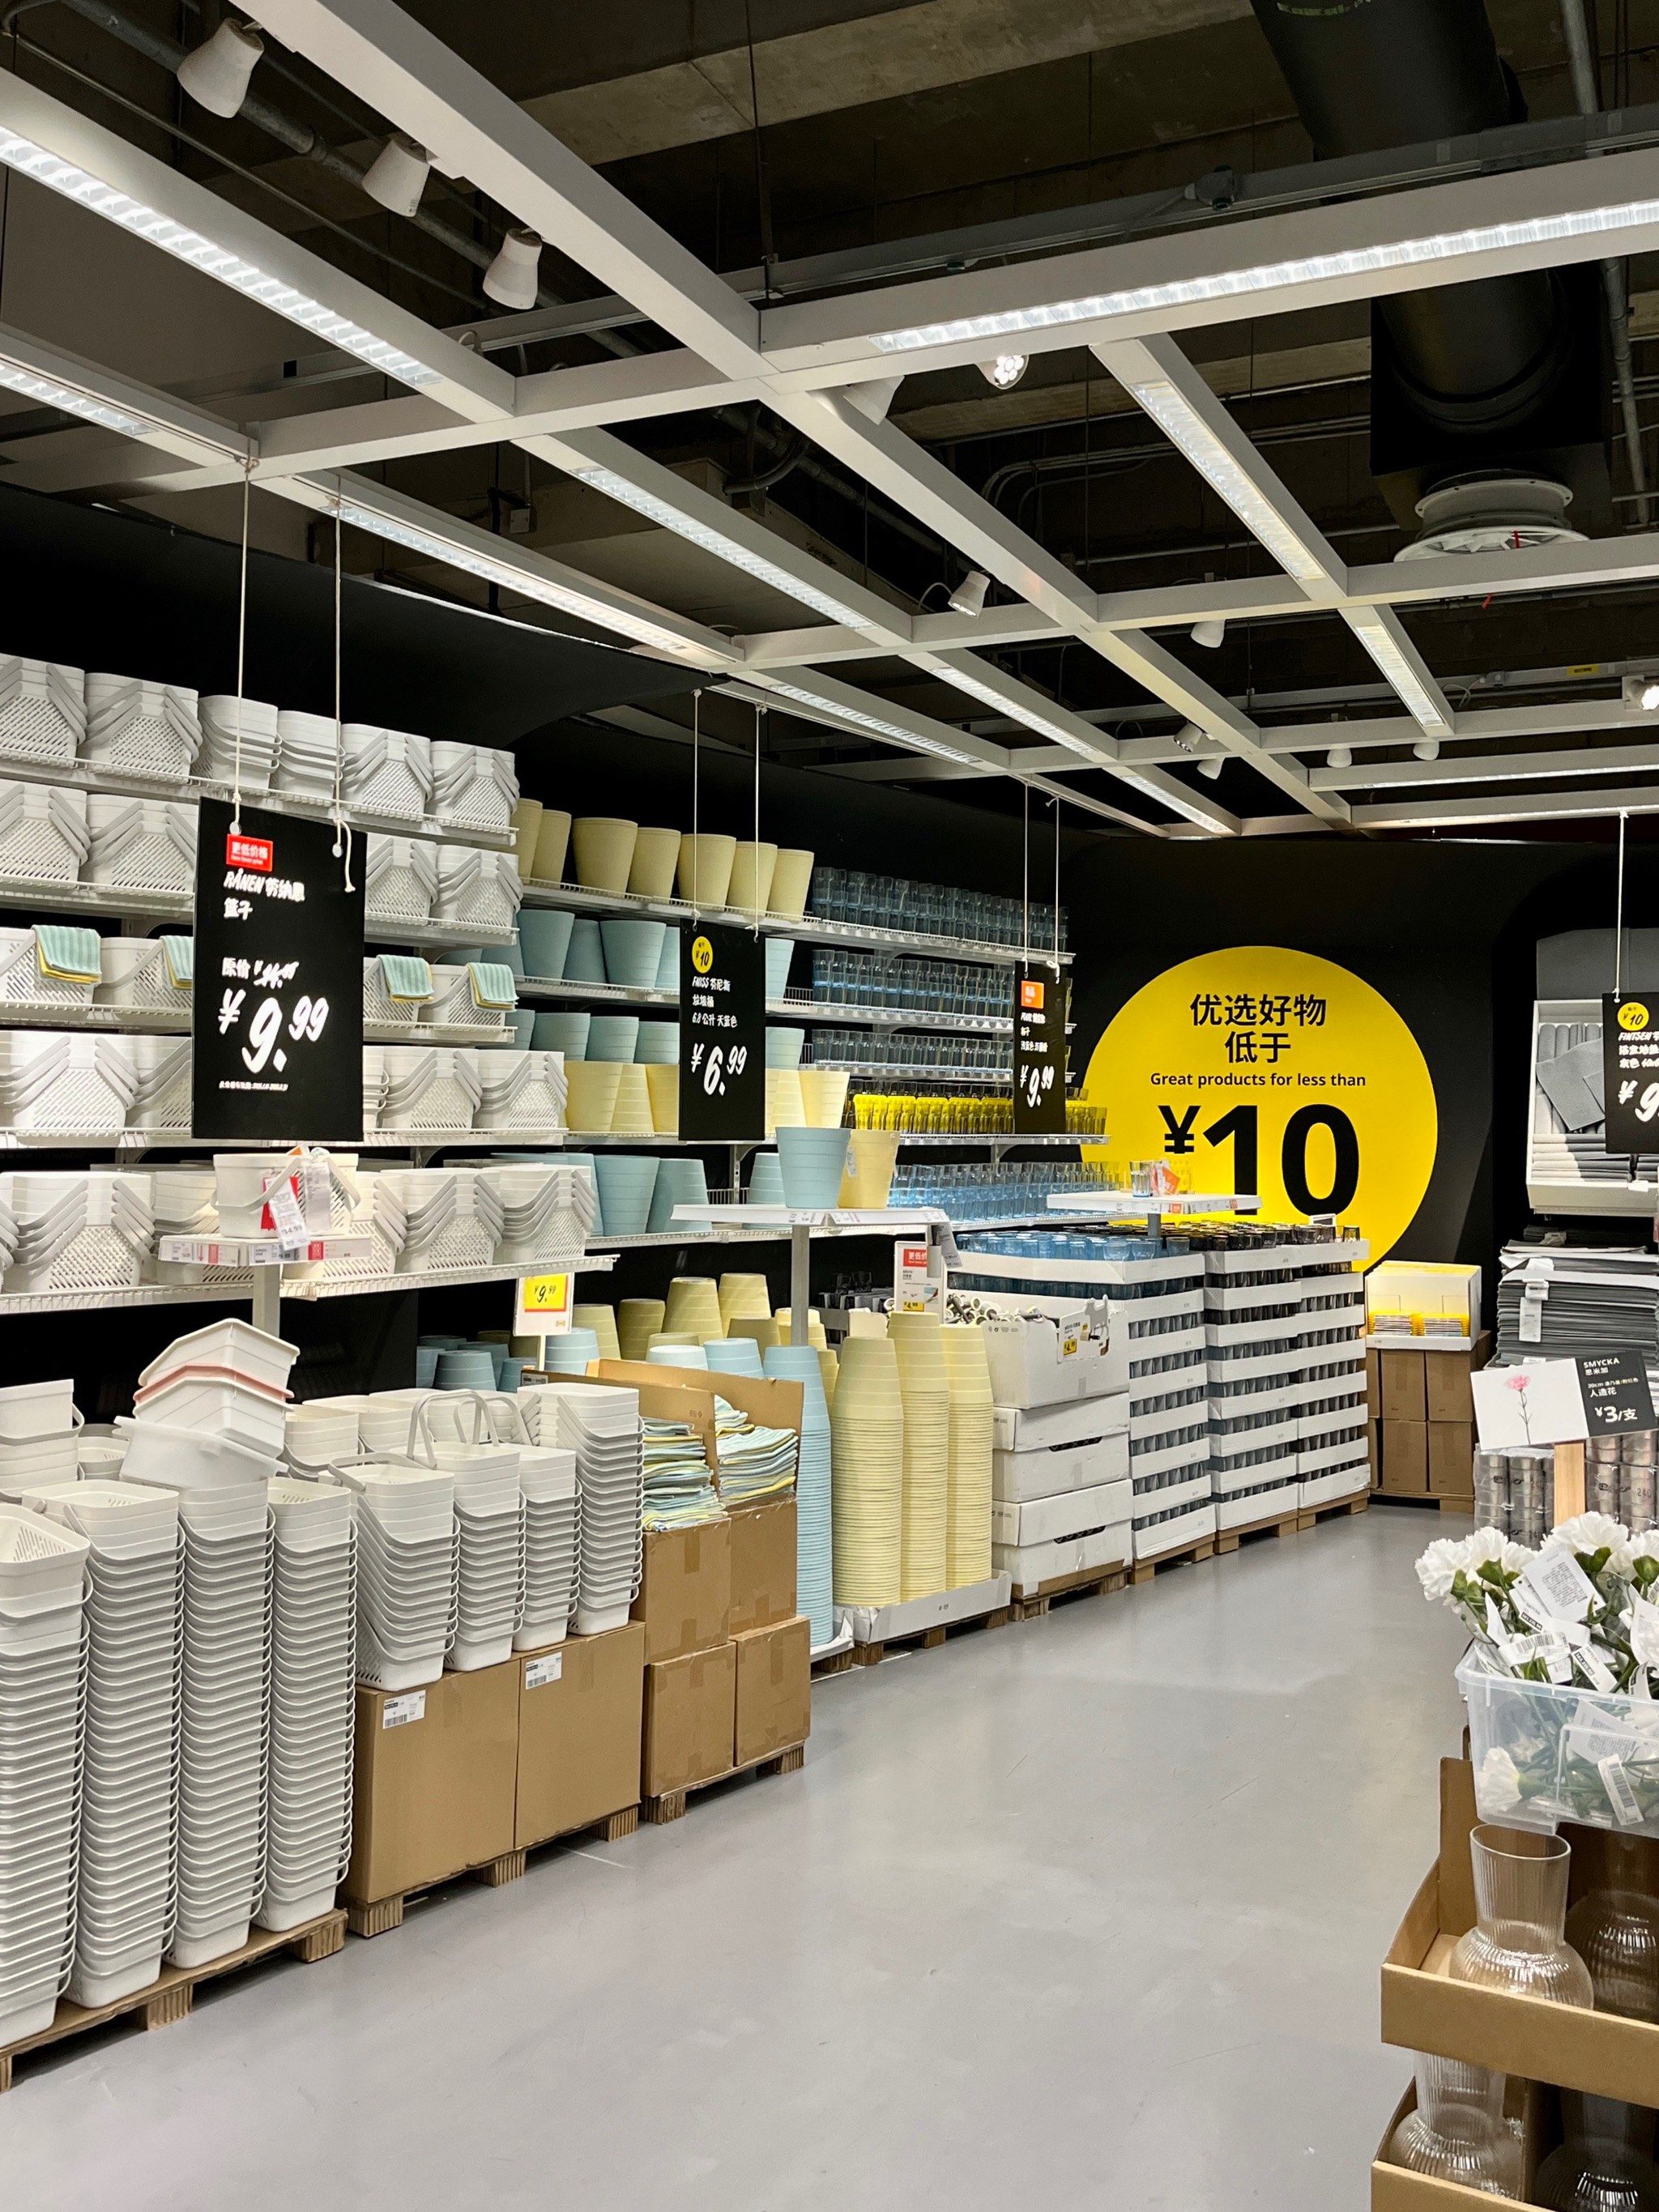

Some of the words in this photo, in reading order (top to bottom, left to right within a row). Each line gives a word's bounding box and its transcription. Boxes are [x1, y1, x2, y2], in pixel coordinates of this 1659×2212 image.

[1190, 993, 1328, 1027] 优选好物
[218, 987, 329, 1074] ¥9.99
[1224, 1031, 1292, 1063] 低于
[691, 1042, 748, 1096] ¥6.99
[1019, 1064, 1055, 1108] ¥9.99
[1150, 1072, 1193, 1087] Great
[1198, 1072, 1266, 1089] products
[1270, 1072, 1294, 1086] for
[1297, 1073, 1327, 1087] less
[1330, 1074, 1367, 1087] than
[1618, 1080, 1659, 1123] ¥9
[1158, 1103, 1360, 1216] ¥10
[1583, 1357, 1620, 1369] SMYCKA
[1590, 1387, 1618, 1398] 人造花
